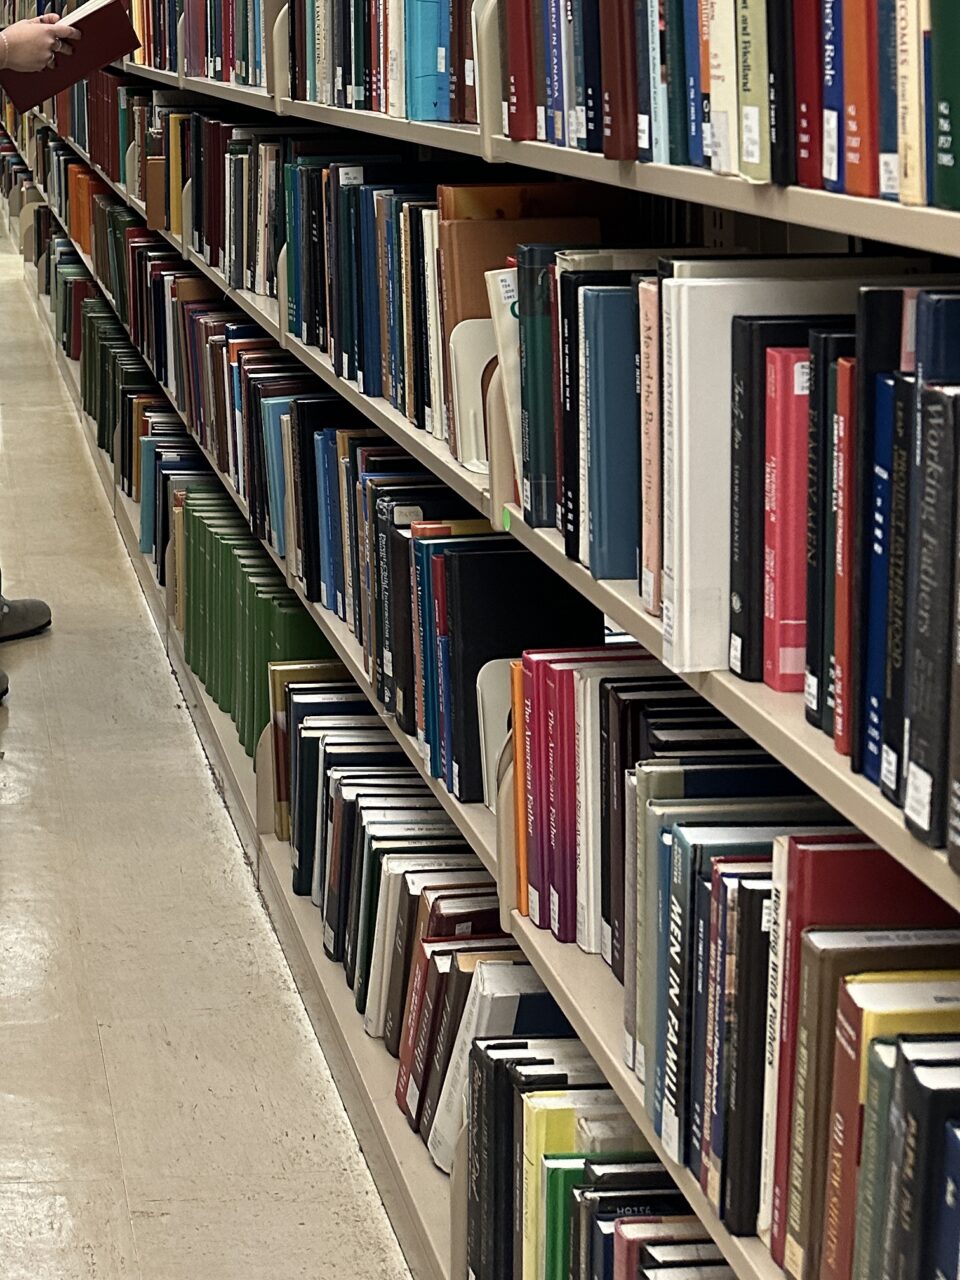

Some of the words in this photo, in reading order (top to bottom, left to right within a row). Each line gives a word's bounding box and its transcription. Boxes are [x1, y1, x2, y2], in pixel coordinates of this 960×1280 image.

[741, 14, 752, 38] and
[552, 47, 560, 99] CANADA
[741, 39, 751, 92] Friedland
[824, 43, 835, 87] Role
[938, 101, 949, 115] HQ
[732, 463, 740, 503] SHAWN
[920, 402, 947, 521] Working
[732, 505, 741, 564] JOHANSEN
[807, 505, 817, 568] MEN
[893, 535, 906, 669] FATHERHOOD
[916, 528, 939, 637] Fathers
[524, 697, 533, 725] The
[525, 727, 533, 790] American
[548, 742, 556, 804] American
[526, 793, 536, 837] Father
[549, 806, 558, 850] Father
[669, 894, 682, 963] MEN
[769, 887, 781, 956] Working
[667, 966, 681, 1006] IN
[708, 940, 716, 978] MEN'S
[768, 958, 779, 1000] With
[706, 979, 715, 1051] TRANSITIONS
[714, 983, 722, 1018] Sense
[767, 1001, 779, 1070] Fathers
[712, 1033, 720, 1115] Fatherhood
[703, 1069, 712, 1142] PARENTHOOD
